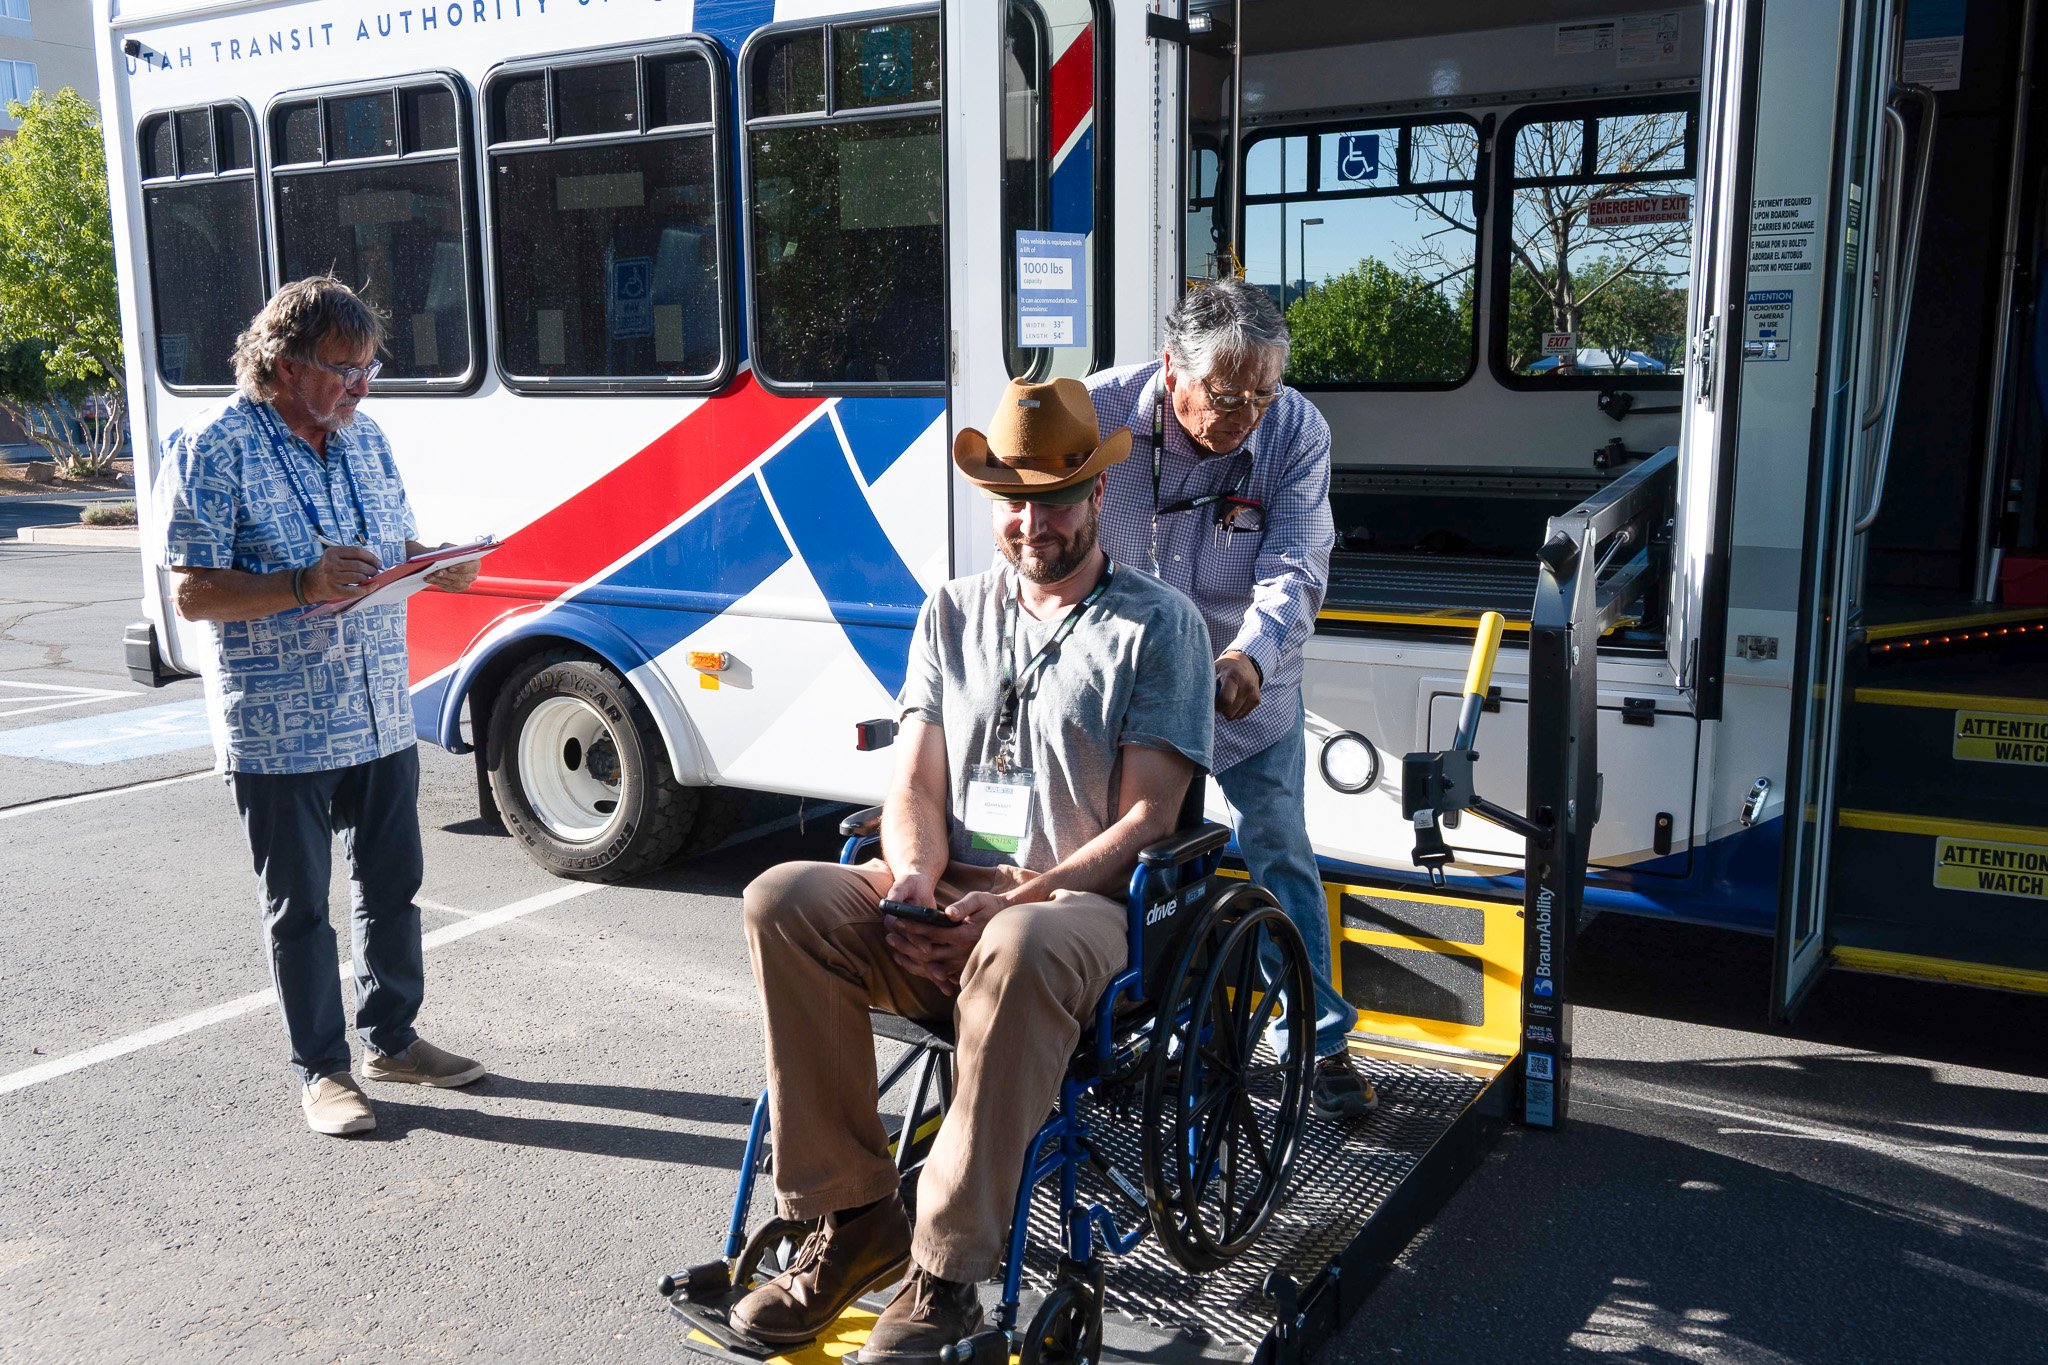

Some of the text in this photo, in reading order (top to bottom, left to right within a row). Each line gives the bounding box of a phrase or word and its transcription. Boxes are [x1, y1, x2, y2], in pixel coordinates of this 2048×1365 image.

[126, 46, 192, 76] UTAH
[211, 23, 333, 63] TRANSIT
[1590, 196, 1688, 216] EMERGENCY EXIT
[1757, 199, 1783, 208] PAYMENT
[1784, 197, 1812, 206] REQUIRED
[1590, 212, 1686, 225] SALIDA DE EMERGENCIA
[1754, 210, 1799, 220] UPON BOARDING
[1758, 222, 1781, 231] CARRIES
[1782, 222, 1791, 230] NO
[1792, 220, 1815, 229] CHANGE
[1020, 237, 1030, 245] This
[1051, 239, 1072, 247] equipped
[1755, 240, 1770, 249] PAGAR
[1771, 240, 1781, 248] POR
[1782, 240, 1788, 248] SU
[1789, 238, 1807, 248] BOLETO
[1752, 252, 1773, 261] ABORDAR
[1774, 252, 1780, 260] EL
[1023, 262, 1064, 274] 1000 lbs
[1778, 262, 1793, 271] POSEE
[1794, 262, 1812, 271] CAMBIO
[1749, 293, 1791, 301] ATTENTION
[1547, 336, 1571, 348] EXIT
[1962, 718, 2048, 740] ATTENTIO
[1995, 742, 2048, 763] WATC
[1943, 846, 2048, 872] ATTENTION
[1978, 871, 2044, 895] WATCH
[1146, 899, 1177, 926] drive
[1536, 886, 1556, 977] BraunAbility
[1530, 1003, 1553, 1012] Century
